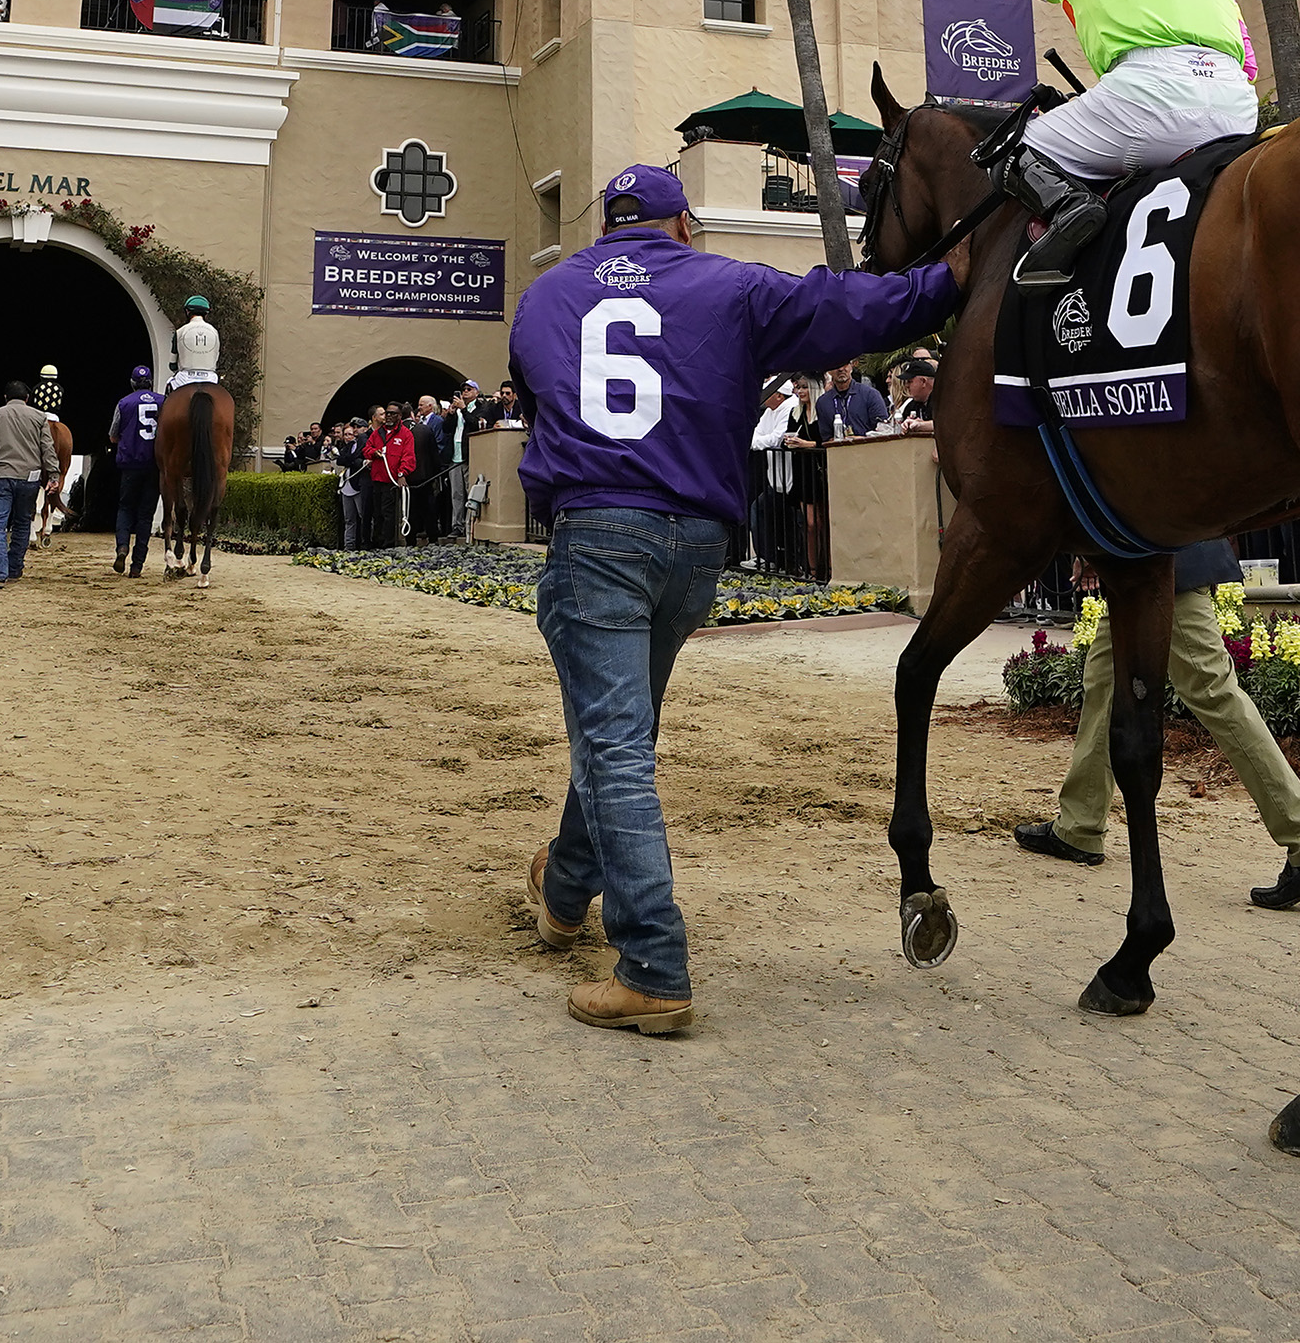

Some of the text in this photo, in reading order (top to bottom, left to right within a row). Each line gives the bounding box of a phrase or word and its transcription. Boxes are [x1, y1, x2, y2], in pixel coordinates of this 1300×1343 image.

[961, 52, 1021, 71] BREEDERS'
[977, 68, 1002, 82] CUP
[1192, 68, 1214, 78] SAEZ
[28, 174, 92, 197] MAR
[627, 214, 638, 222] MAR
[357, 249, 419, 263] WELCOME
[423, 254, 438, 263] TO
[442, 255, 465, 264] THE
[1107, 177, 1191, 348] 6
[324, 265, 495, 288] BREEDERS' CUP
[339, 288, 480, 303] WORLD CHAMPIONSHIPS
[618, 282, 637, 291] CUP
[580, 297, 662, 440] 6
[1105, 381, 1173, 416] SOFIA
[138, 404, 158, 441] 5
